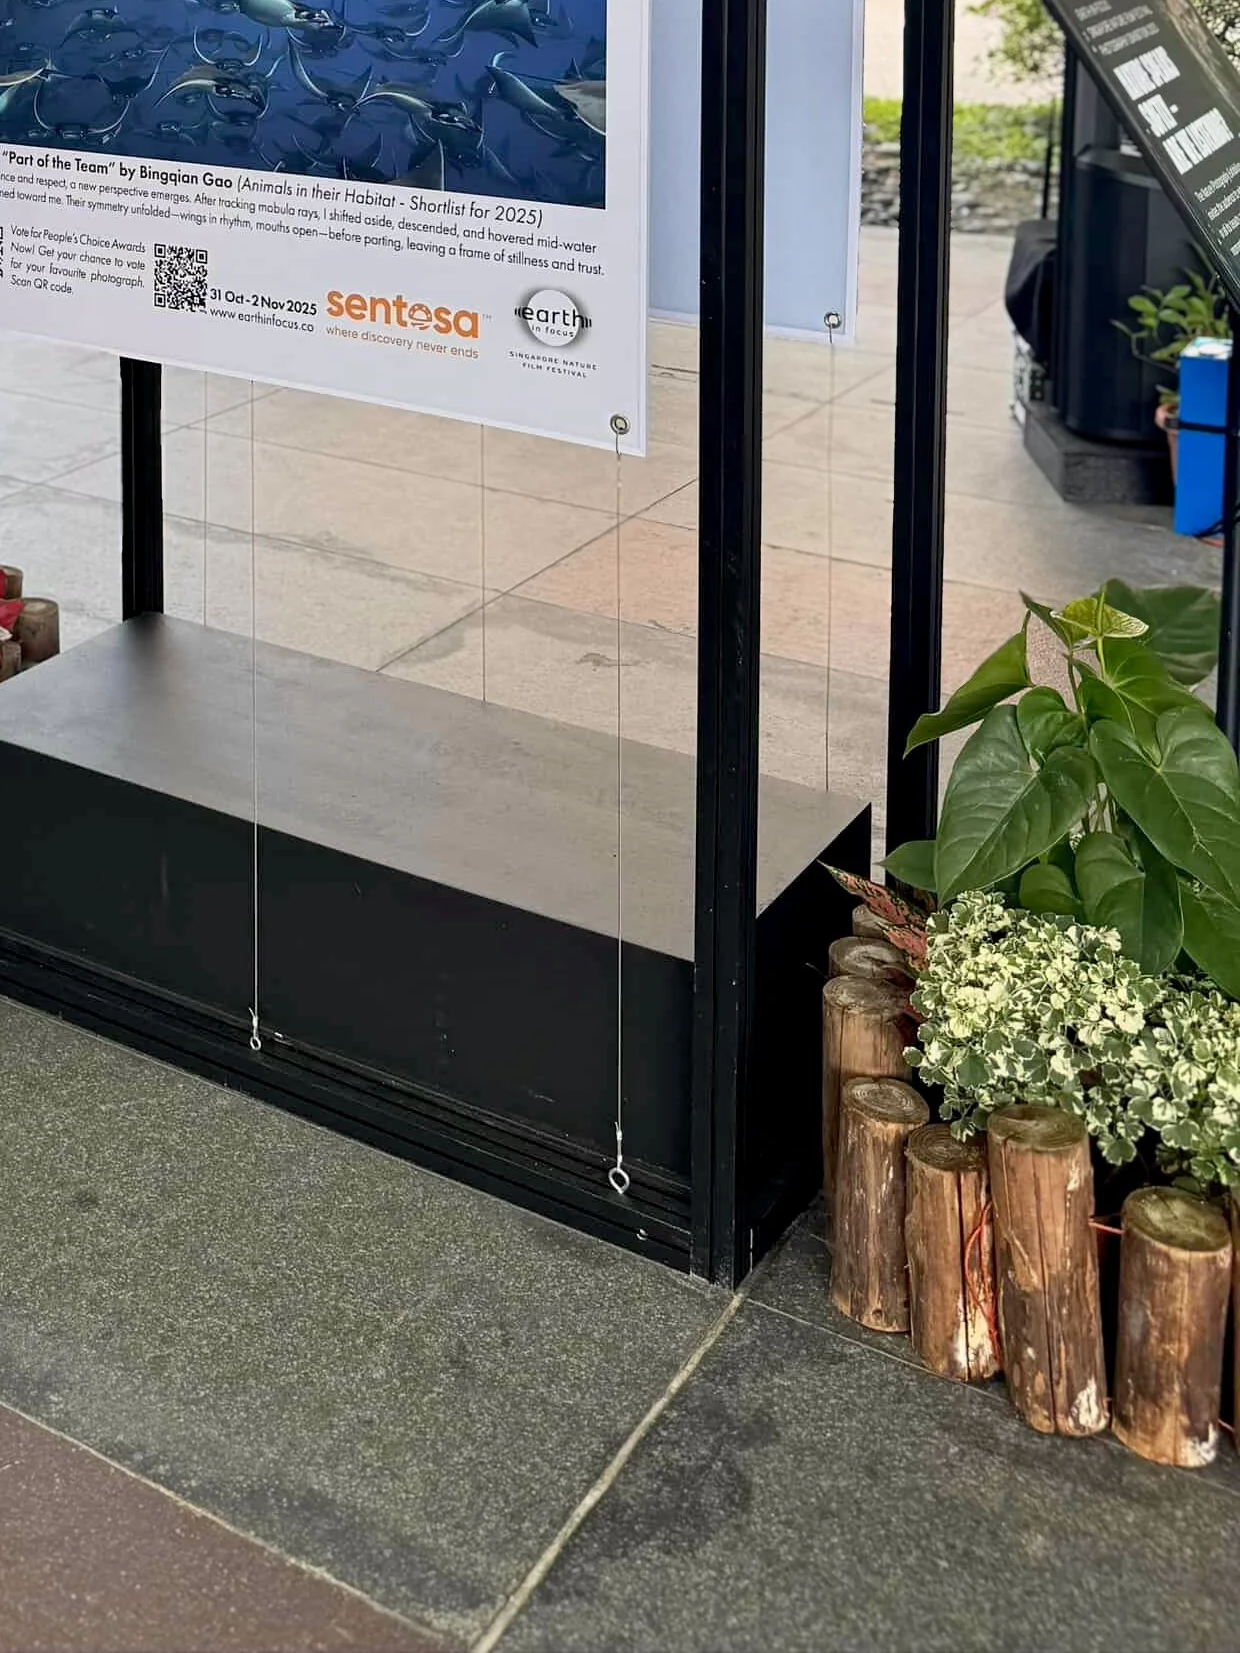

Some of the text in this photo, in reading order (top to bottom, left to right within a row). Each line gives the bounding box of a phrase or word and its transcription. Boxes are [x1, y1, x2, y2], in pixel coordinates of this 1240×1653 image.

[17, 173, 35, 186] and
[36, 178, 68, 190] respect,
[70, 181, 76, 189] a
[79, 183, 97, 194] new
[99, 185, 149, 197] perspective
[151, 191, 191, 204] emerges.
[194, 193, 217, 207] After
[217, 197, 255, 214] tracking
[258, 202, 295, 218] mobula
[298, 209, 320, 221] rays,
[329, 212, 361, 224] shifted
[364, 217, 394, 230] aside,
[398, 220, 459, 238] descended,
[463, 227, 485, 239] and
[488, 229, 534, 246] hovered
[37, 154, 50, 168] of
[52, 155, 71, 170] the
[120, 162, 136, 181] by
[140, 165, 198, 186] Bingqian
[203, 170, 232, 188] Gao
[237, 175, 292, 195] (Animals
[296, 183, 307, 197] in
[312, 183, 341, 201] their
[345, 188, 397, 208] Habitat
[409, 195, 466, 216] Shortlist
[470, 201, 491, 218] for
[495, 205, 543, 228] 2025)
[17, 191, 46, 202] toward
[49, 196, 63, 206] me.
[66, 196, 86, 207] Their
[88, 201, 130, 216] symmetry
[209, 213, 217, 224] in
[220, 215, 253, 231] rhythm,
[256, 221, 290, 234] mouths
[364, 235, 403, 251] parting,
[407, 237, 445, 257] leaving
[449, 247, 456, 255] a
[459, 244, 490, 260] frame
[493, 250, 505, 264] of
[508, 252, 549, 268] stillness
[552, 259, 576, 273] and
[578, 262, 604, 275] trust.
[210, 288, 222, 301] 31
[225, 290, 243, 305] Oct
[251, 295, 259, 307] 2
[261, 296, 286, 311] Nov
[286, 300, 317, 316] 2025
[210, 309, 314, 333] wwwearthinfocus.co
[326, 290, 480, 339] sentosa
[326, 326, 479, 359] where discovery never ends
[545, 327, 574, 337] focus
